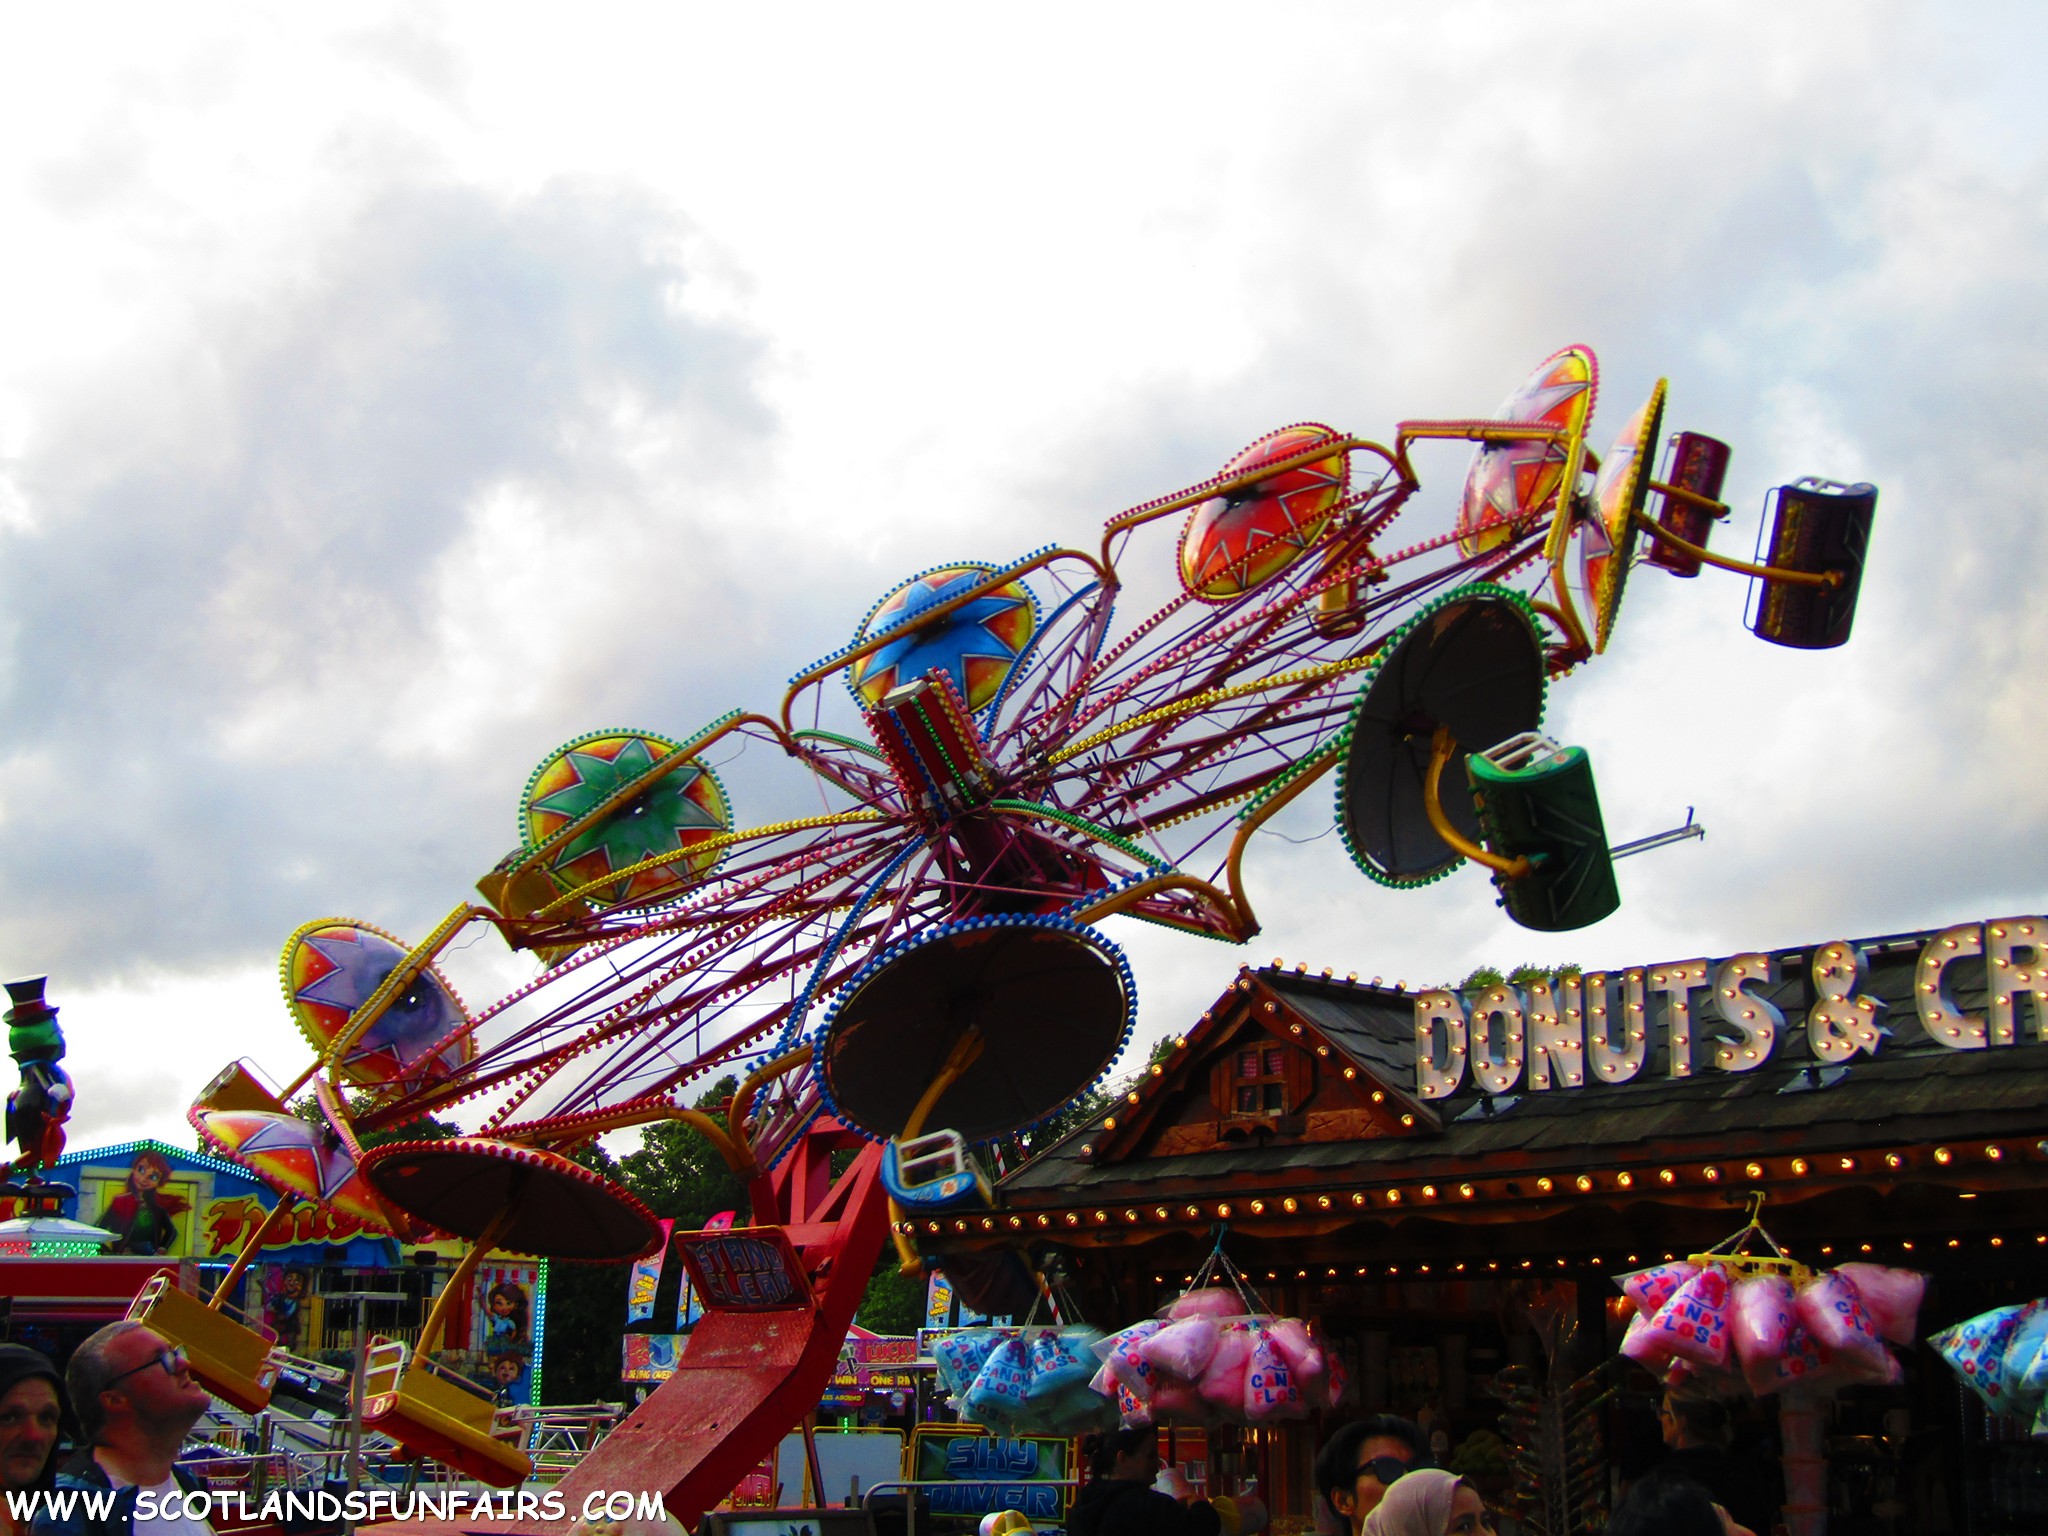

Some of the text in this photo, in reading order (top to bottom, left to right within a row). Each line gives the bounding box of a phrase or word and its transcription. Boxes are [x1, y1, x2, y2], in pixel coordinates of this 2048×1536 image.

[1414, 953, 1786, 1100] DONUTS
[1809, 940, 1889, 1062] &
[696, 1237, 785, 1273] STAND
[703, 1271, 794, 1305] CLEAR
[1653, 1314, 1720, 1349] FLOSS
[1663, 1301, 1725, 1331] CANDY
[866, 1341, 917, 1360] LUCKY
[955, 1335, 981, 1372] CAND
[834, 1375, 858, 1385] WIN
[870, 1375, 894, 1386] ONE
[976, 1379, 1028, 1401] FLOSS
[945, 1437, 1041, 1474] SKY
[209, 1478, 239, 1487] YORK
[925, 1485, 1061, 1519] DIVER
